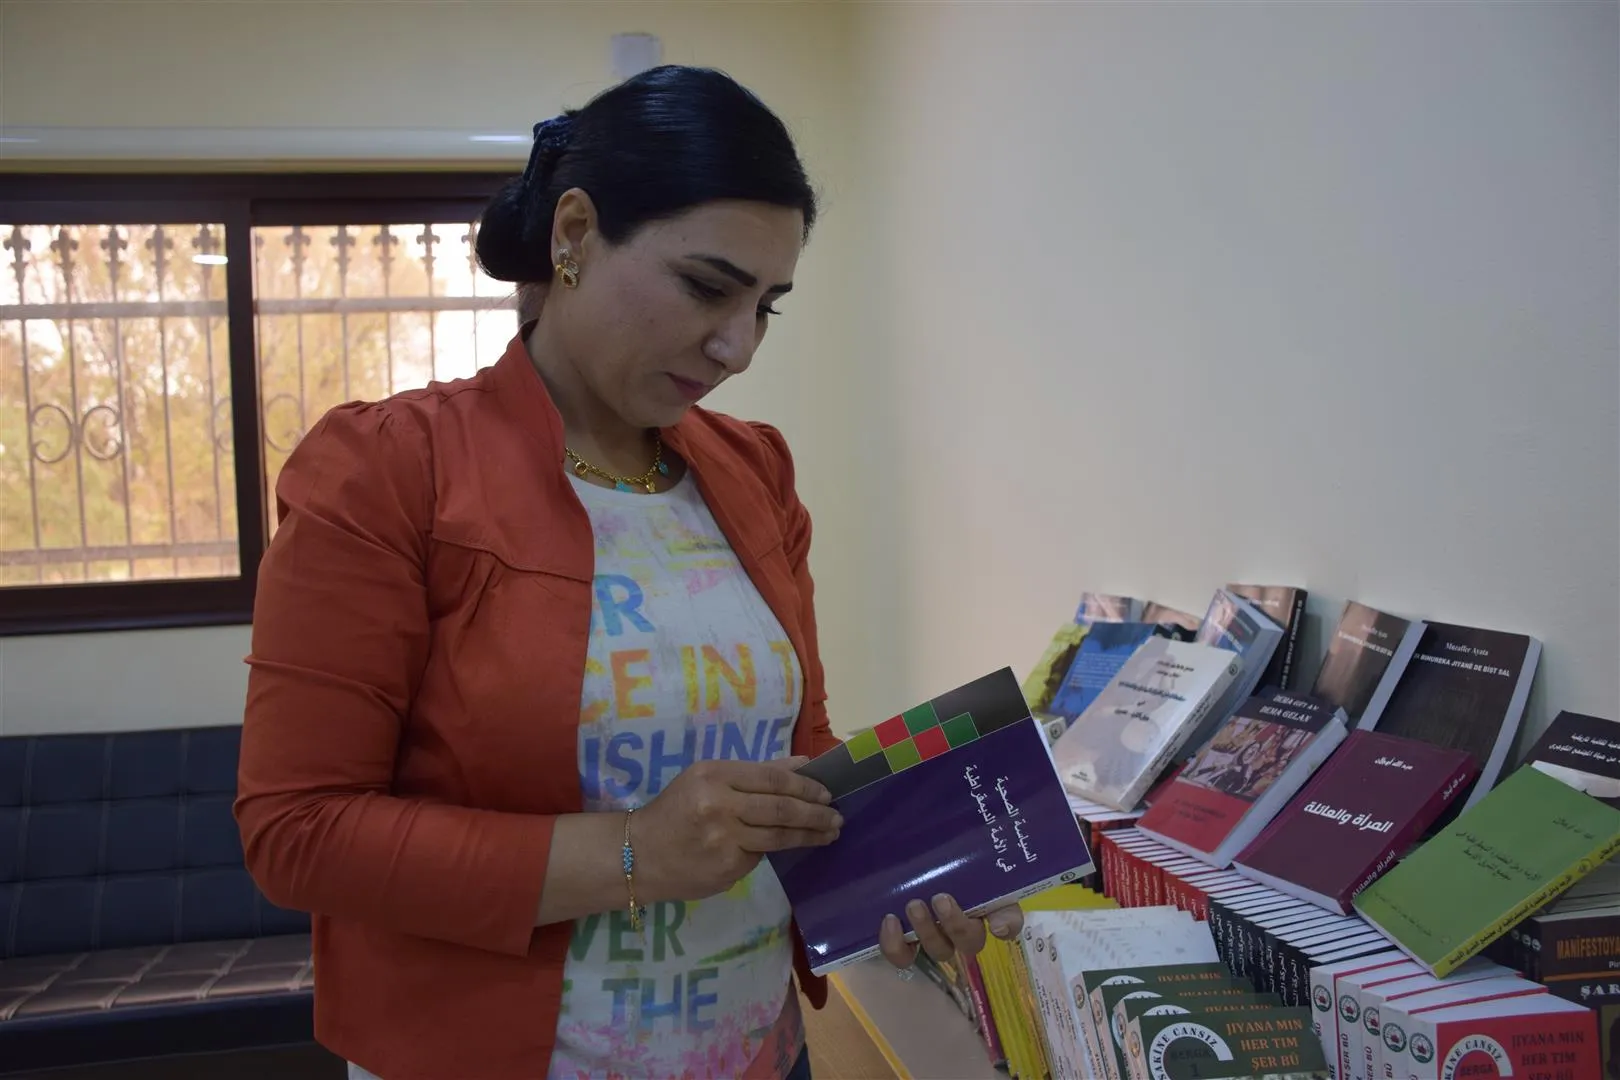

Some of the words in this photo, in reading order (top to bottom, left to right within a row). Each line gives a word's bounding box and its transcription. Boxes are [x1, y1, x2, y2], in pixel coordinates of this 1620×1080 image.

[681, 642, 757, 715] IN
[963, 764, 996, 825] الديمقراطية
[994, 776, 1020, 818] الصحية
[1303, 800, 1353, 825] والعائلة
[1352, 812, 1395, 833] المرأة
[1014, 819, 1038, 863] السياسة
[996, 858, 1017, 873] في
[602, 966, 720, 1034] THE
[1225, 1020, 1274, 1036] JIYANA
[1276, 1018, 1304, 1031] MIN
[1240, 1038, 1269, 1052] HER
[1271, 1036, 1300, 1049] TIM
[1511, 1031, 1555, 1048] JIYANA
[1558, 1030, 1585, 1043] MIN
[1250, 1055, 1278, 1071] ŞER
[1521, 1052, 1550, 1066] HER
[1551, 1051, 1577, 1064] TIM
